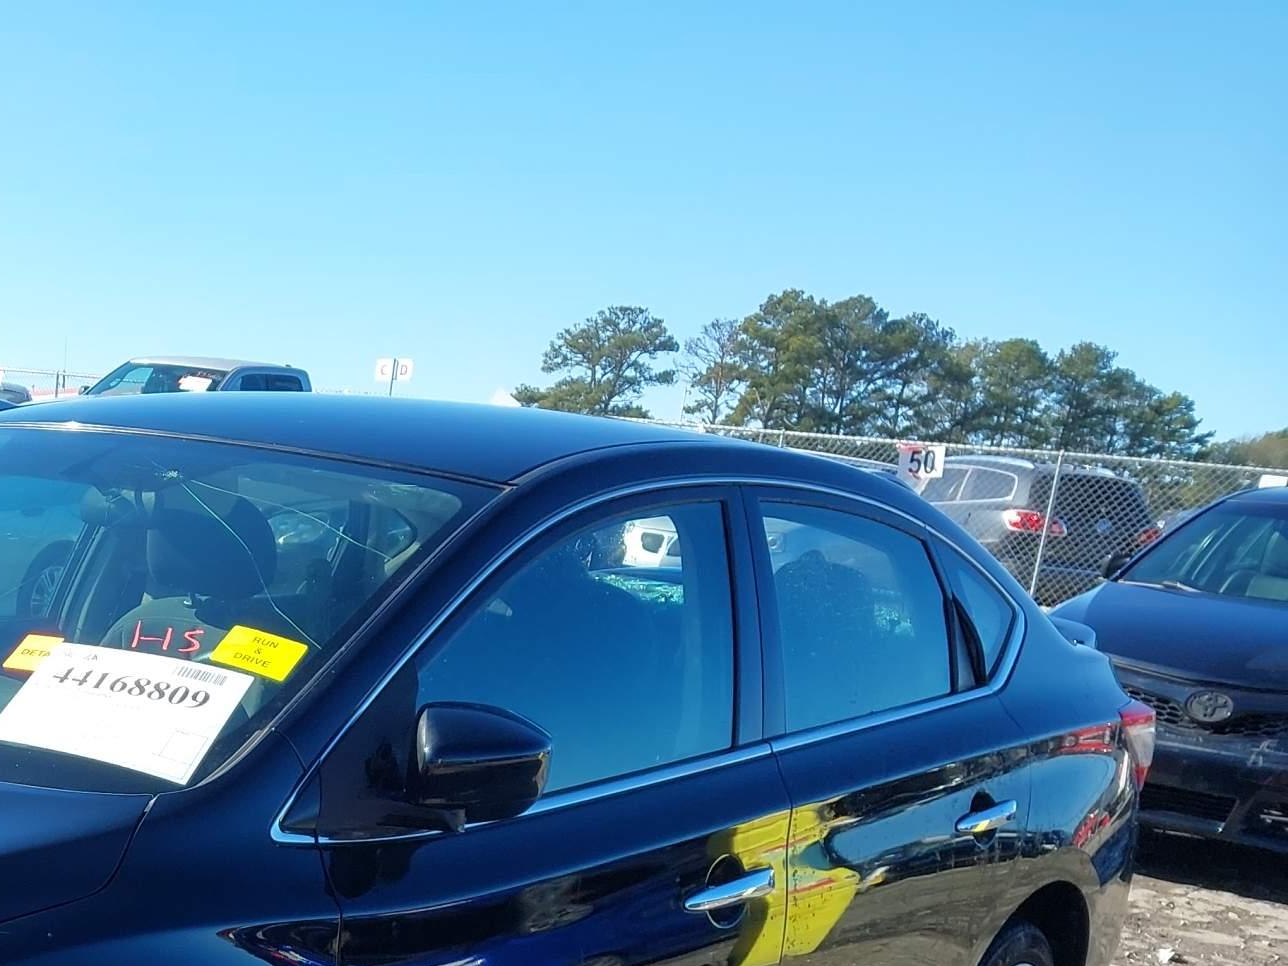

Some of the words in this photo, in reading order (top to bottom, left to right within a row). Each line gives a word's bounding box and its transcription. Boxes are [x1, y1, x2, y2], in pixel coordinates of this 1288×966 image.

[908, 450, 936, 474] 50
[252, 636, 280, 649] RUN
[21, 648, 51, 657] DETA
[254, 647, 262, 655] &
[233, 652, 272, 668] DRIVE
[52, 667, 211, 708] 44168809
